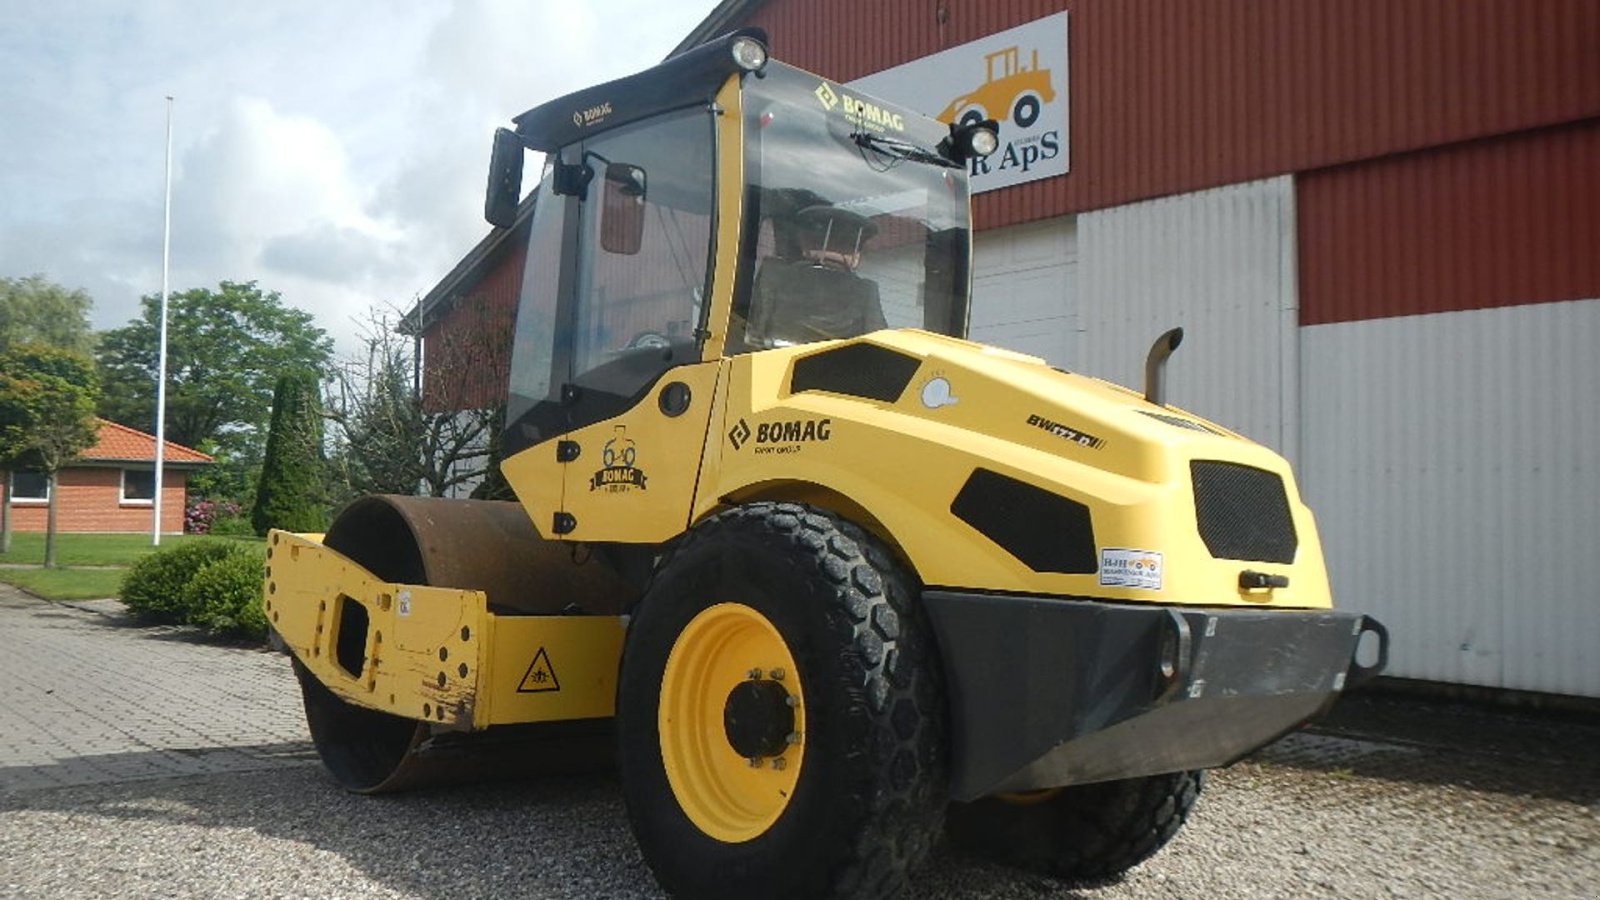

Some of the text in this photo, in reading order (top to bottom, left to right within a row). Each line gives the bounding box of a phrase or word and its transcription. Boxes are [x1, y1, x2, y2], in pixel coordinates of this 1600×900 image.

[842, 94, 905, 132] BOMAG
[999, 131, 1059, 172] ApS
[756, 418, 831, 443] BOMAG
[602, 469, 634, 482] BOMAG
